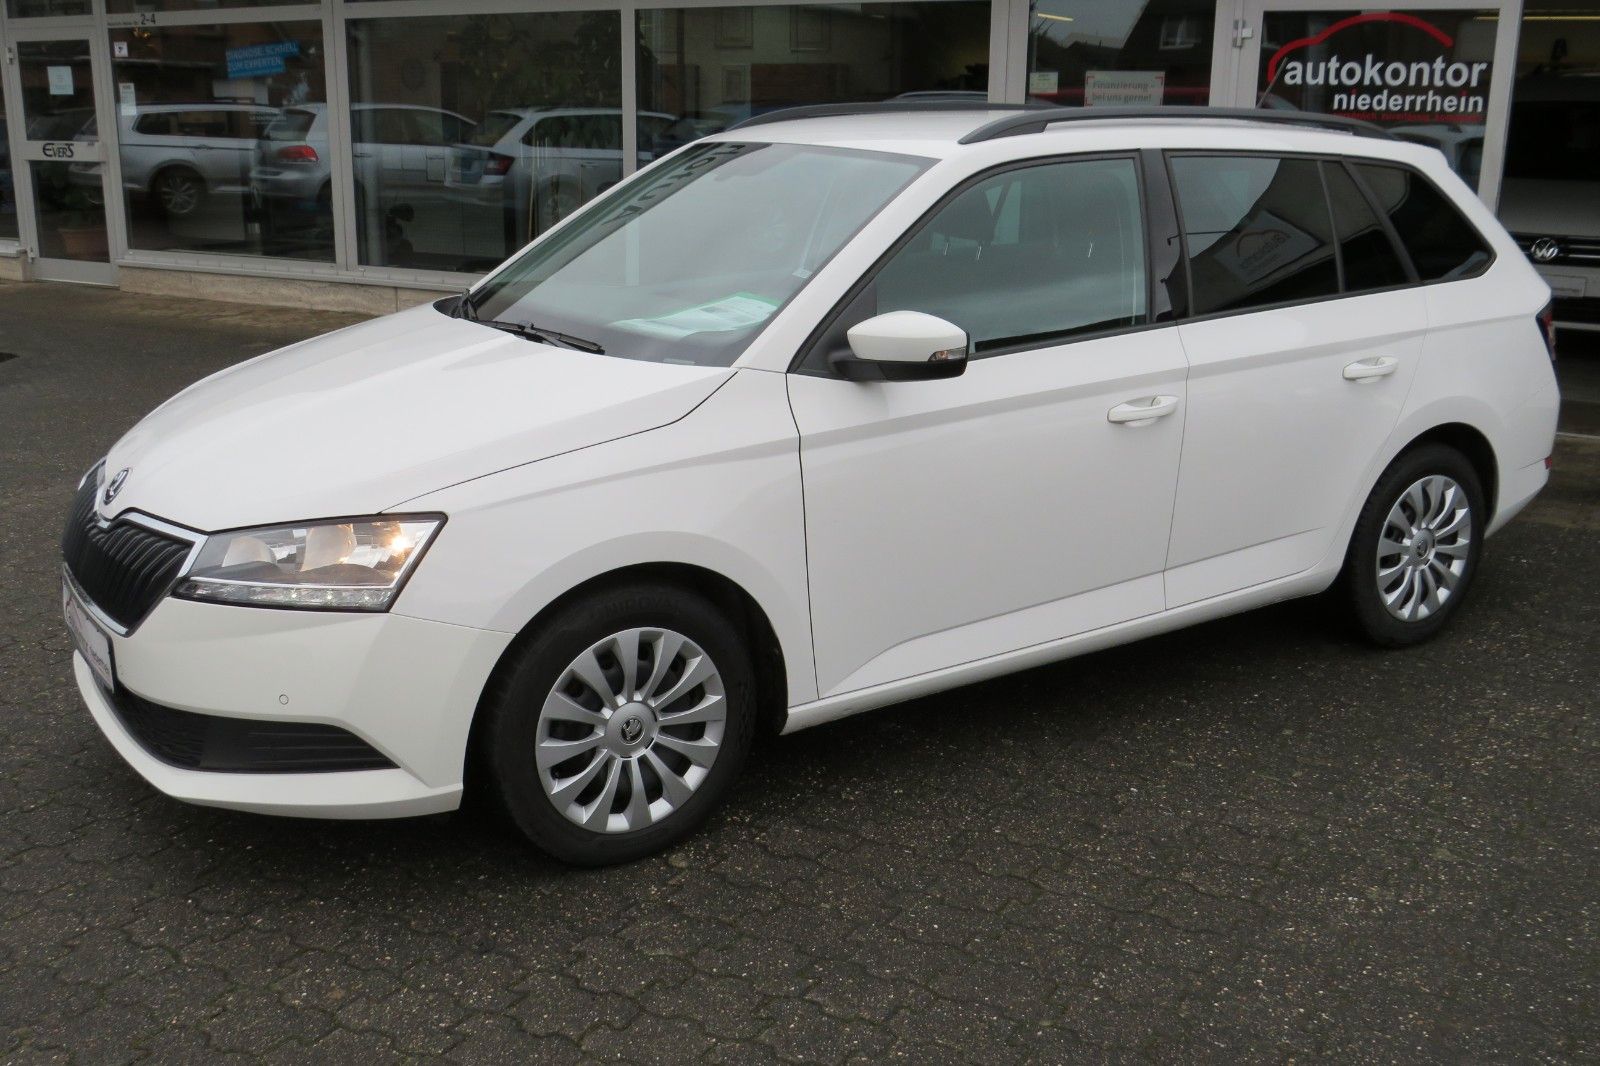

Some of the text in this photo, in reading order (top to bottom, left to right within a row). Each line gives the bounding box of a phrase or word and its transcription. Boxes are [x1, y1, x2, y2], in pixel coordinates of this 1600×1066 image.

[141, 13, 156, 25] 2-4
[1284, 53, 1488, 88] autokontor
[1333, 87, 1484, 113] niederrhein
